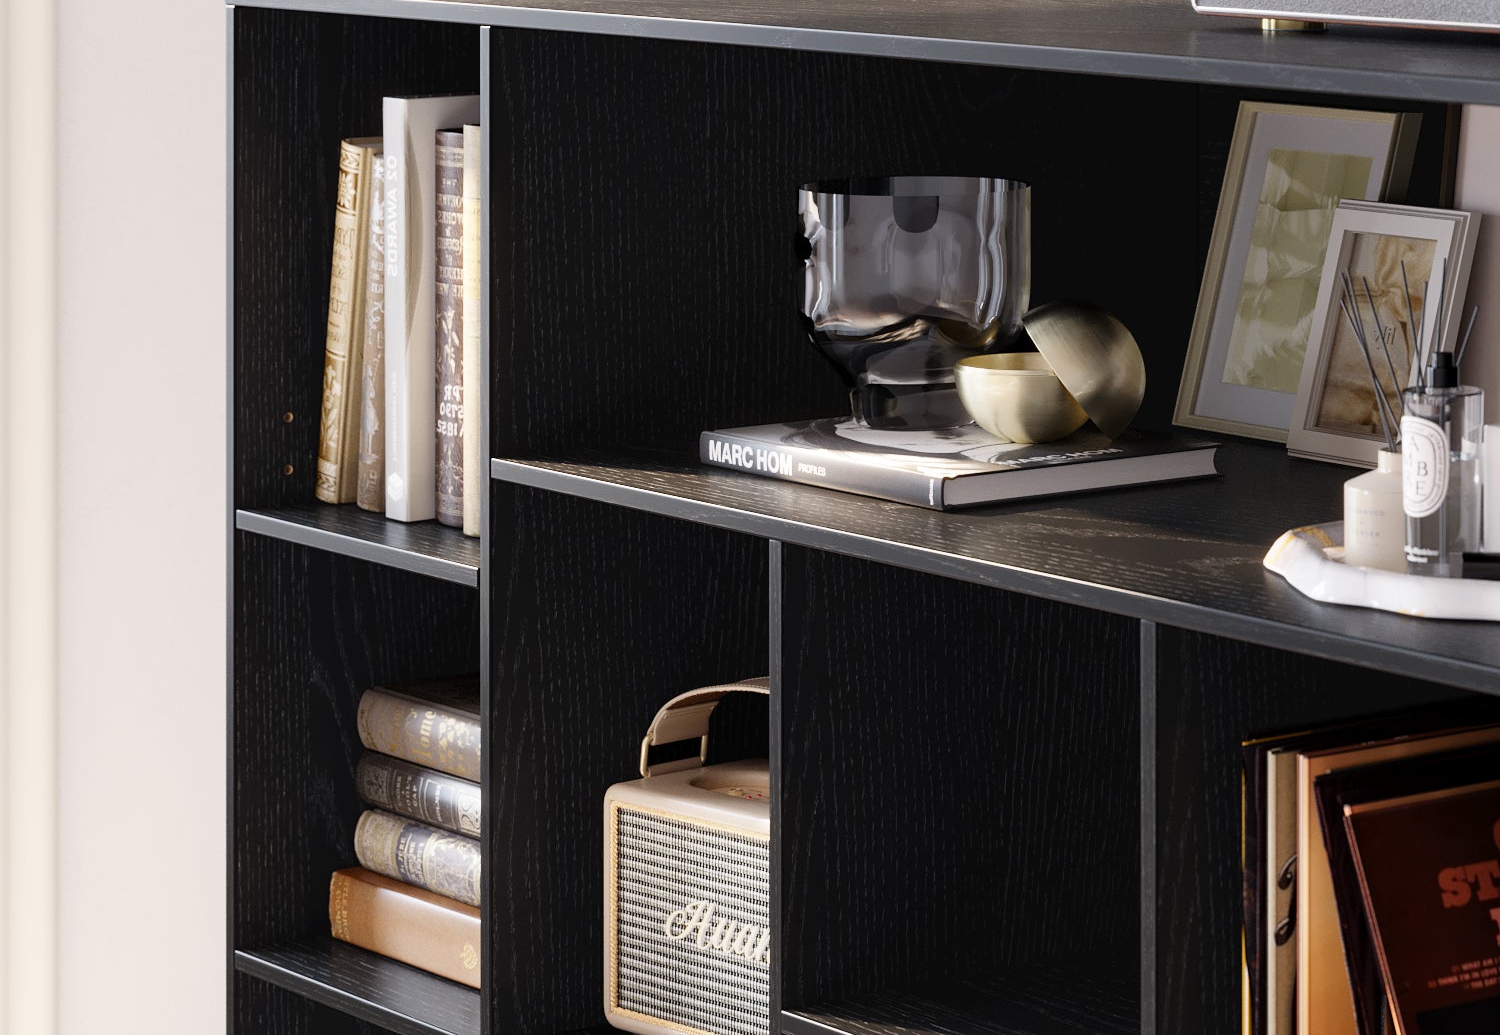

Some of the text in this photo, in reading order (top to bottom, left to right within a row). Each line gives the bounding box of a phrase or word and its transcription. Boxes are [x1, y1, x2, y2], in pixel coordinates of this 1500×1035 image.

[709, 439, 827, 477] MARC HOM PROFILES
